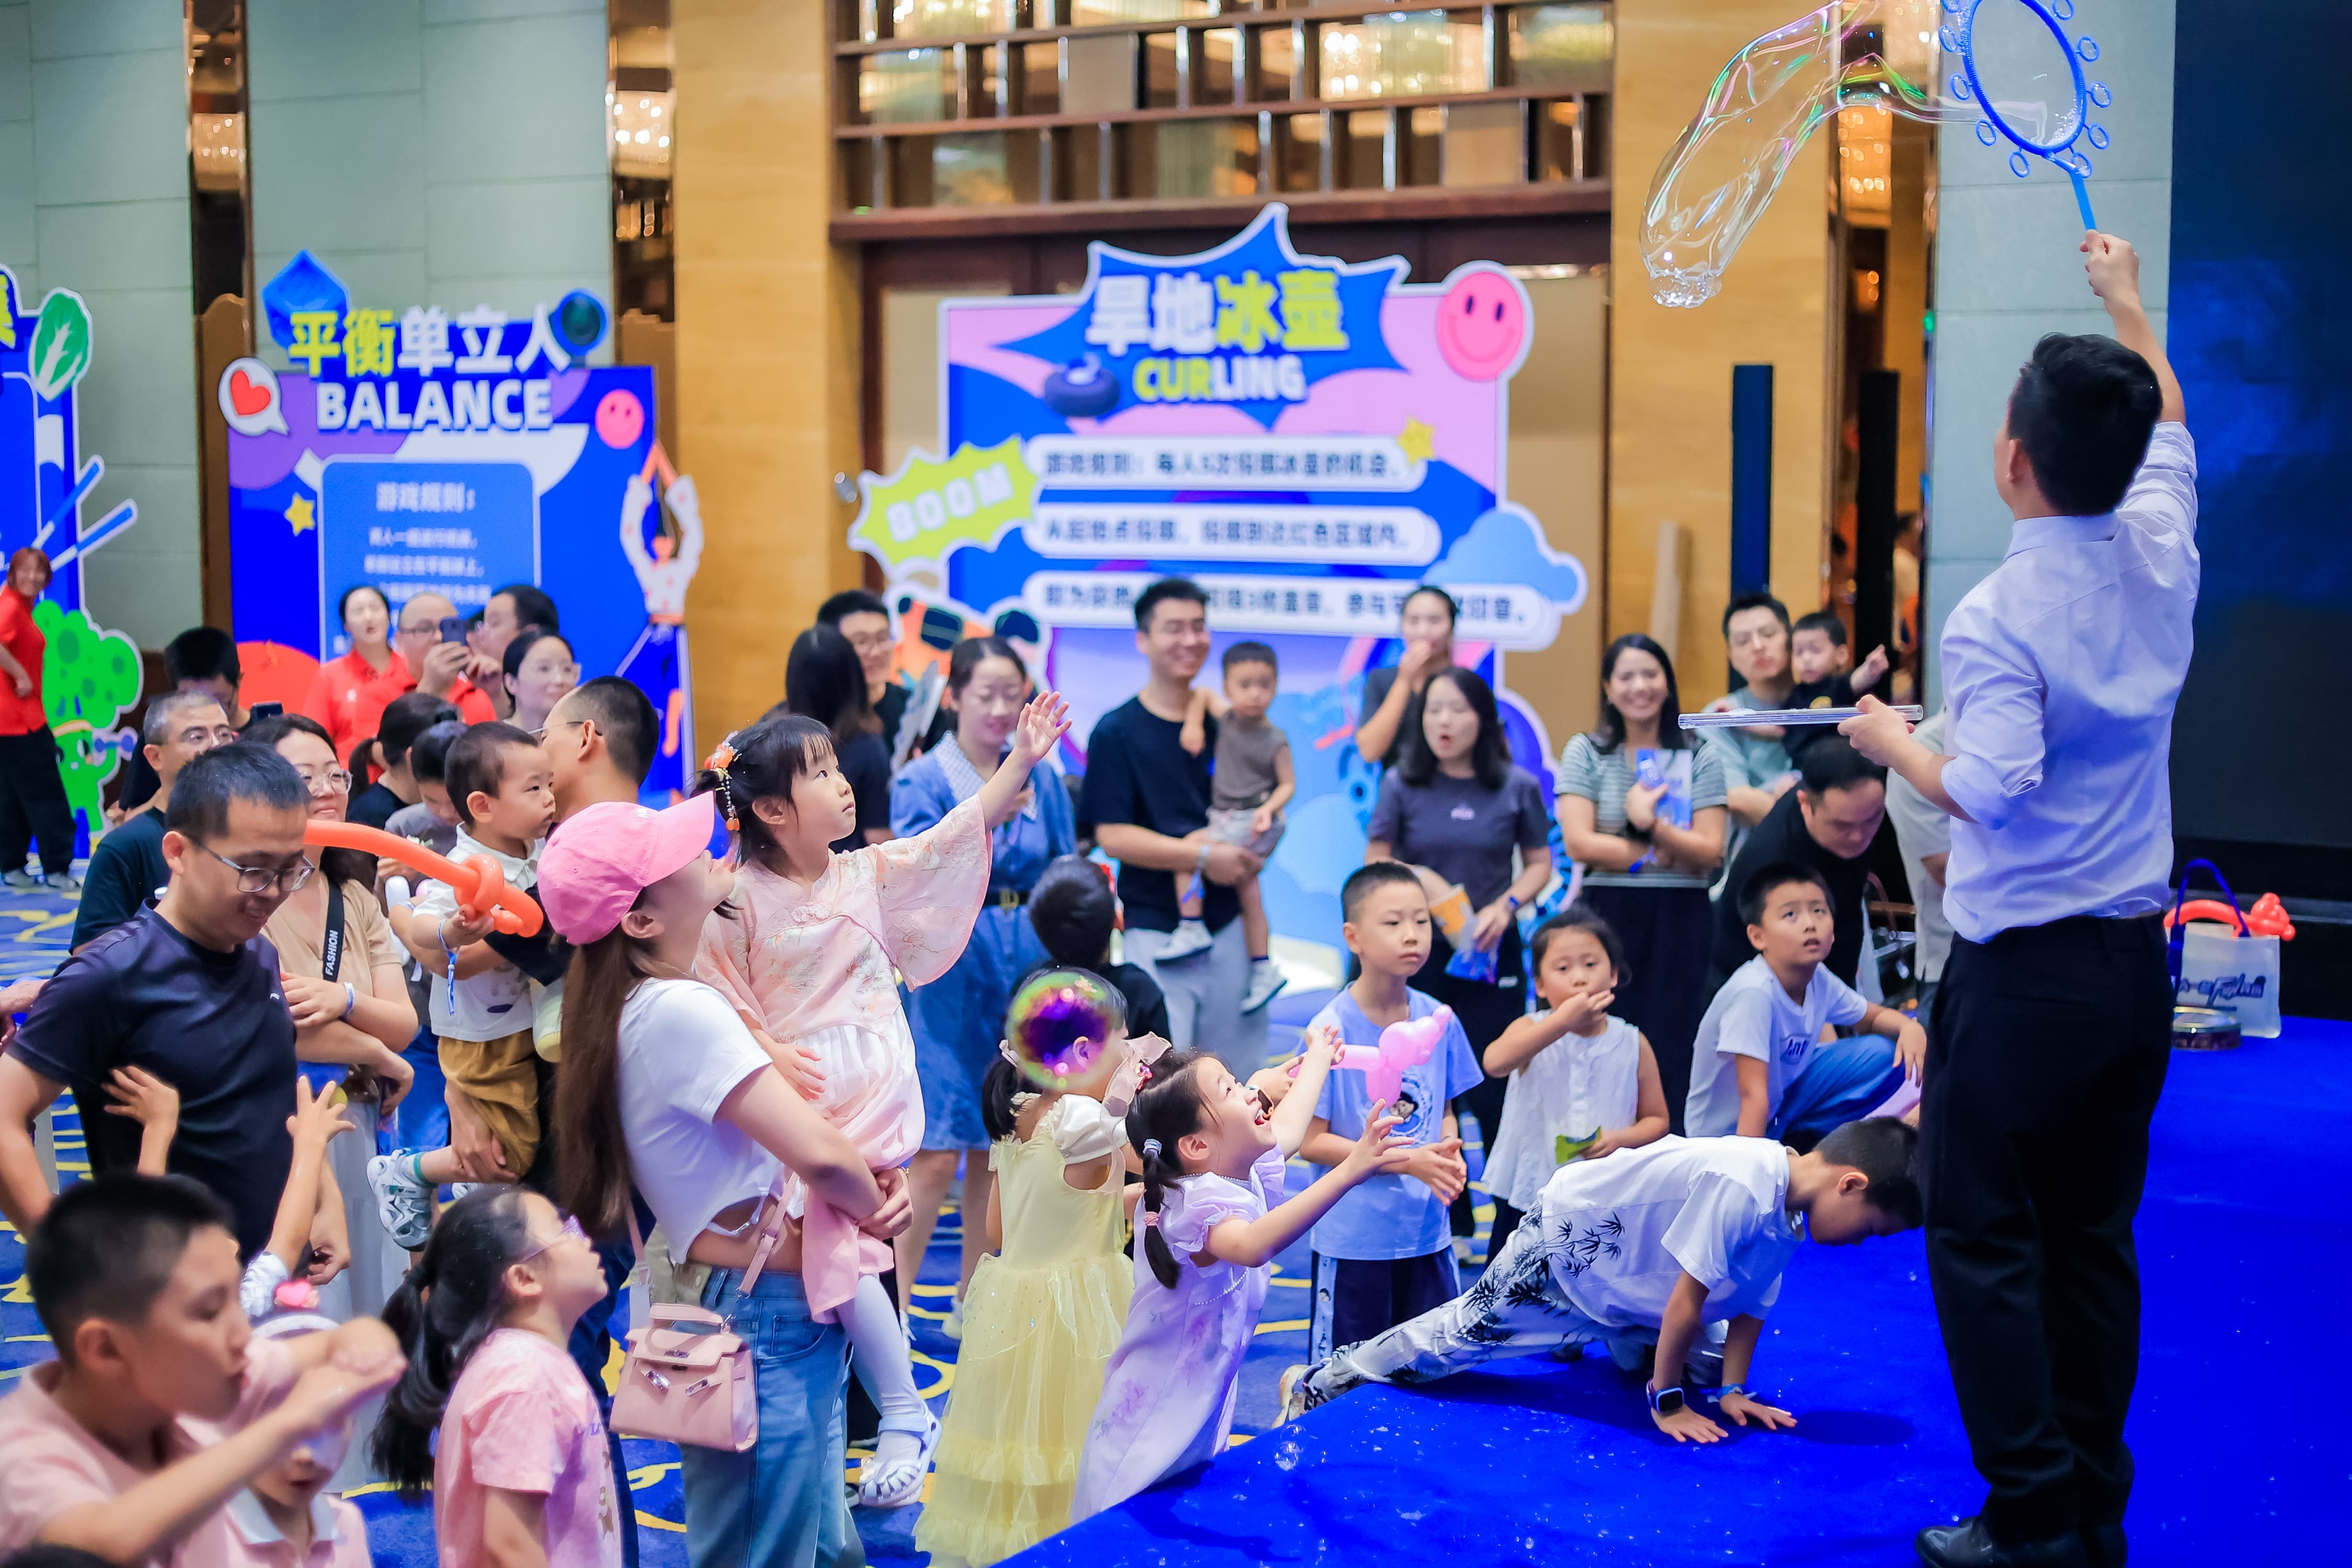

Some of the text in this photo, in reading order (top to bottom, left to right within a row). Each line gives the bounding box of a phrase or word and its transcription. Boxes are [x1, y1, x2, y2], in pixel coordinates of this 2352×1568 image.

[289, 303, 572, 377] 平衡单立人
[1085, 270, 1348, 356] 旱地冰壶
[316, 379, 552, 430] BALANCE
[1133, 354, 1307, 401] CURLING
[886, 463, 1015, 543] BOOM
[325, 929, 339, 976] FASHION
